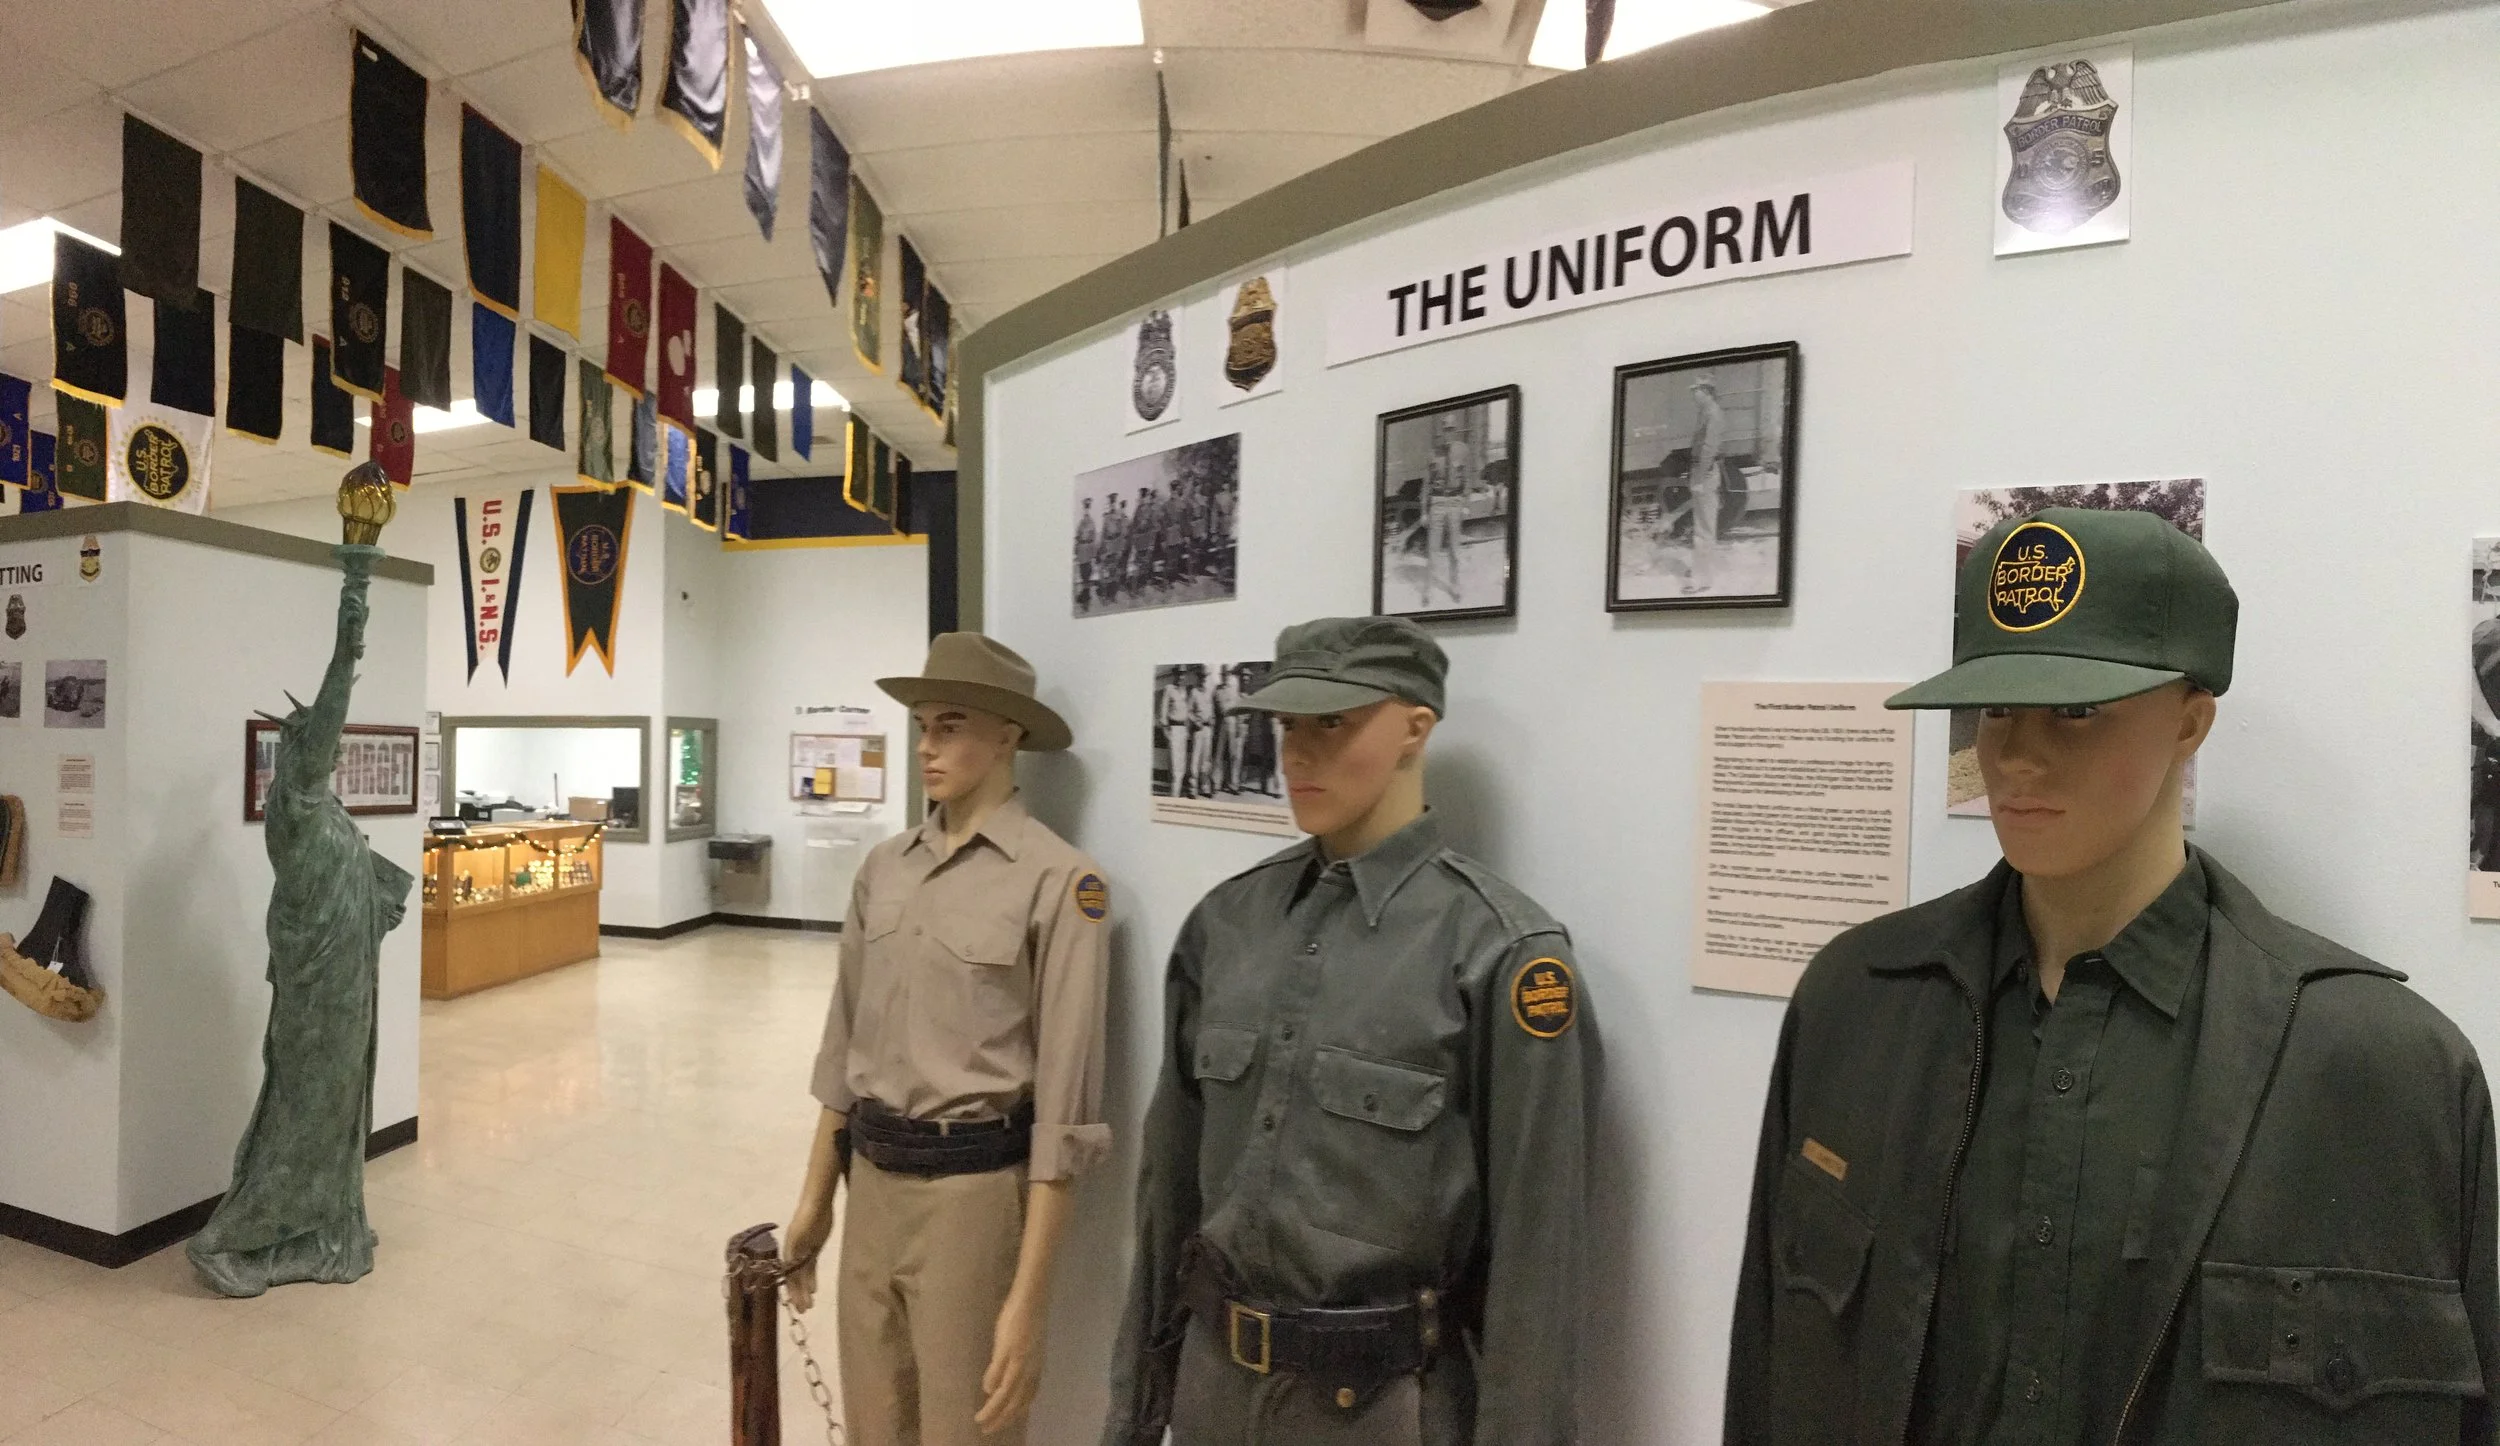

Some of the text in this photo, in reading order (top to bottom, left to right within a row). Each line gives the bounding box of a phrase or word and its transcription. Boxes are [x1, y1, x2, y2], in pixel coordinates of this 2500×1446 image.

[2018, 115, 2104, 147] BORDER PATROL
[1388, 193, 1811, 337] THE UNIFORM
[149, 436, 159, 492] BORDER
[160, 439, 172, 493] PATROL
[481, 500, 503, 545] U.S.
[2018, 544, 2049, 561] U.S.
[1997, 566, 2068, 586] BORDER
[1997, 587, 2065, 606] PATROL
